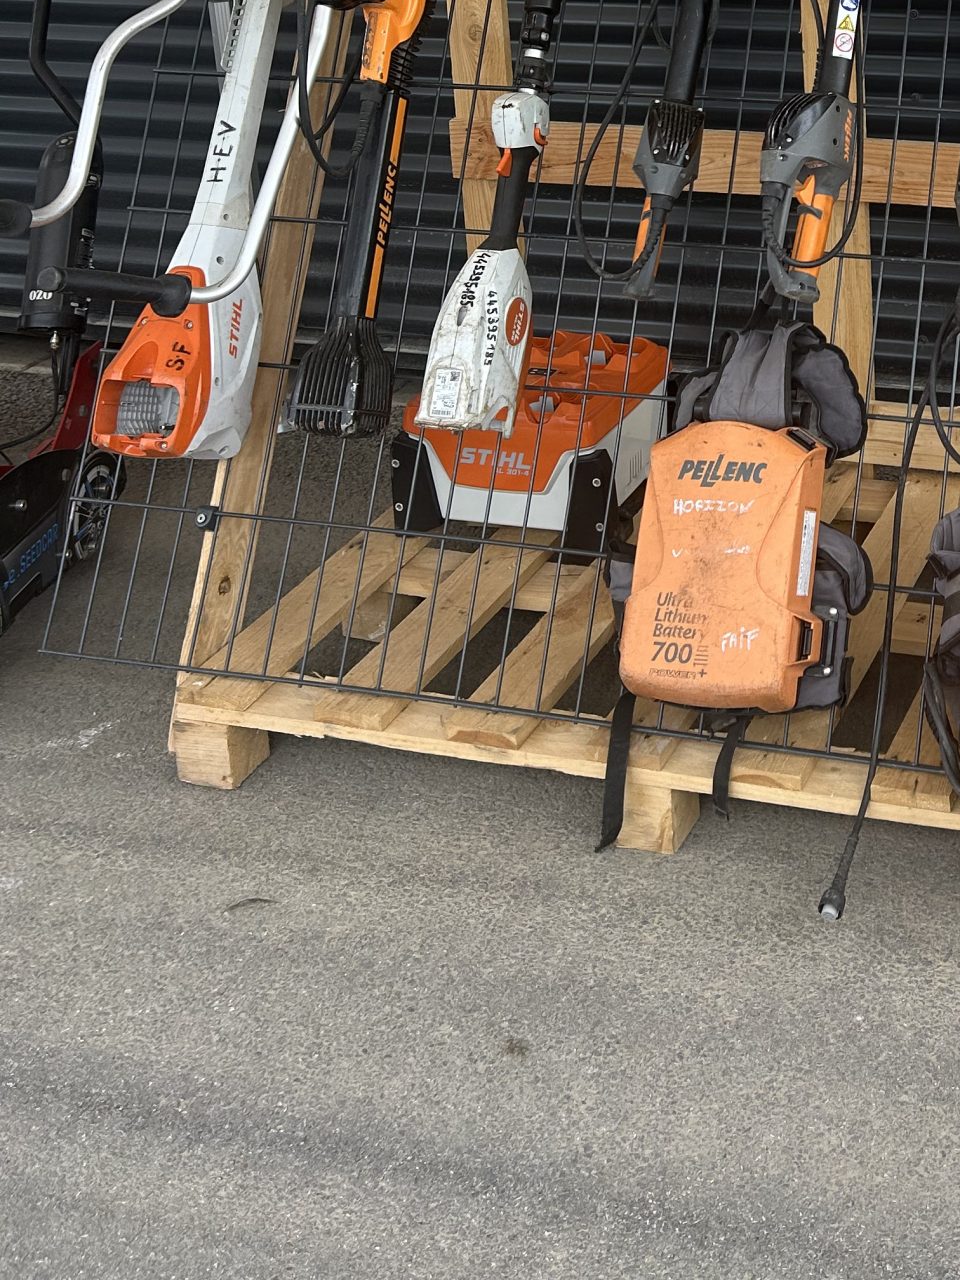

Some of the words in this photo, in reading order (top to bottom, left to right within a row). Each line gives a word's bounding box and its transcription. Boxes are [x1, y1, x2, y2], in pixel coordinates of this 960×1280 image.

[377, 164, 397, 246] PELLENC
[228, 299, 243, 359] STIHL
[678, 453, 768, 487] PELLENC
[656, 591, 693, 608] Ultra
[651, 641, 693, 664] 700
